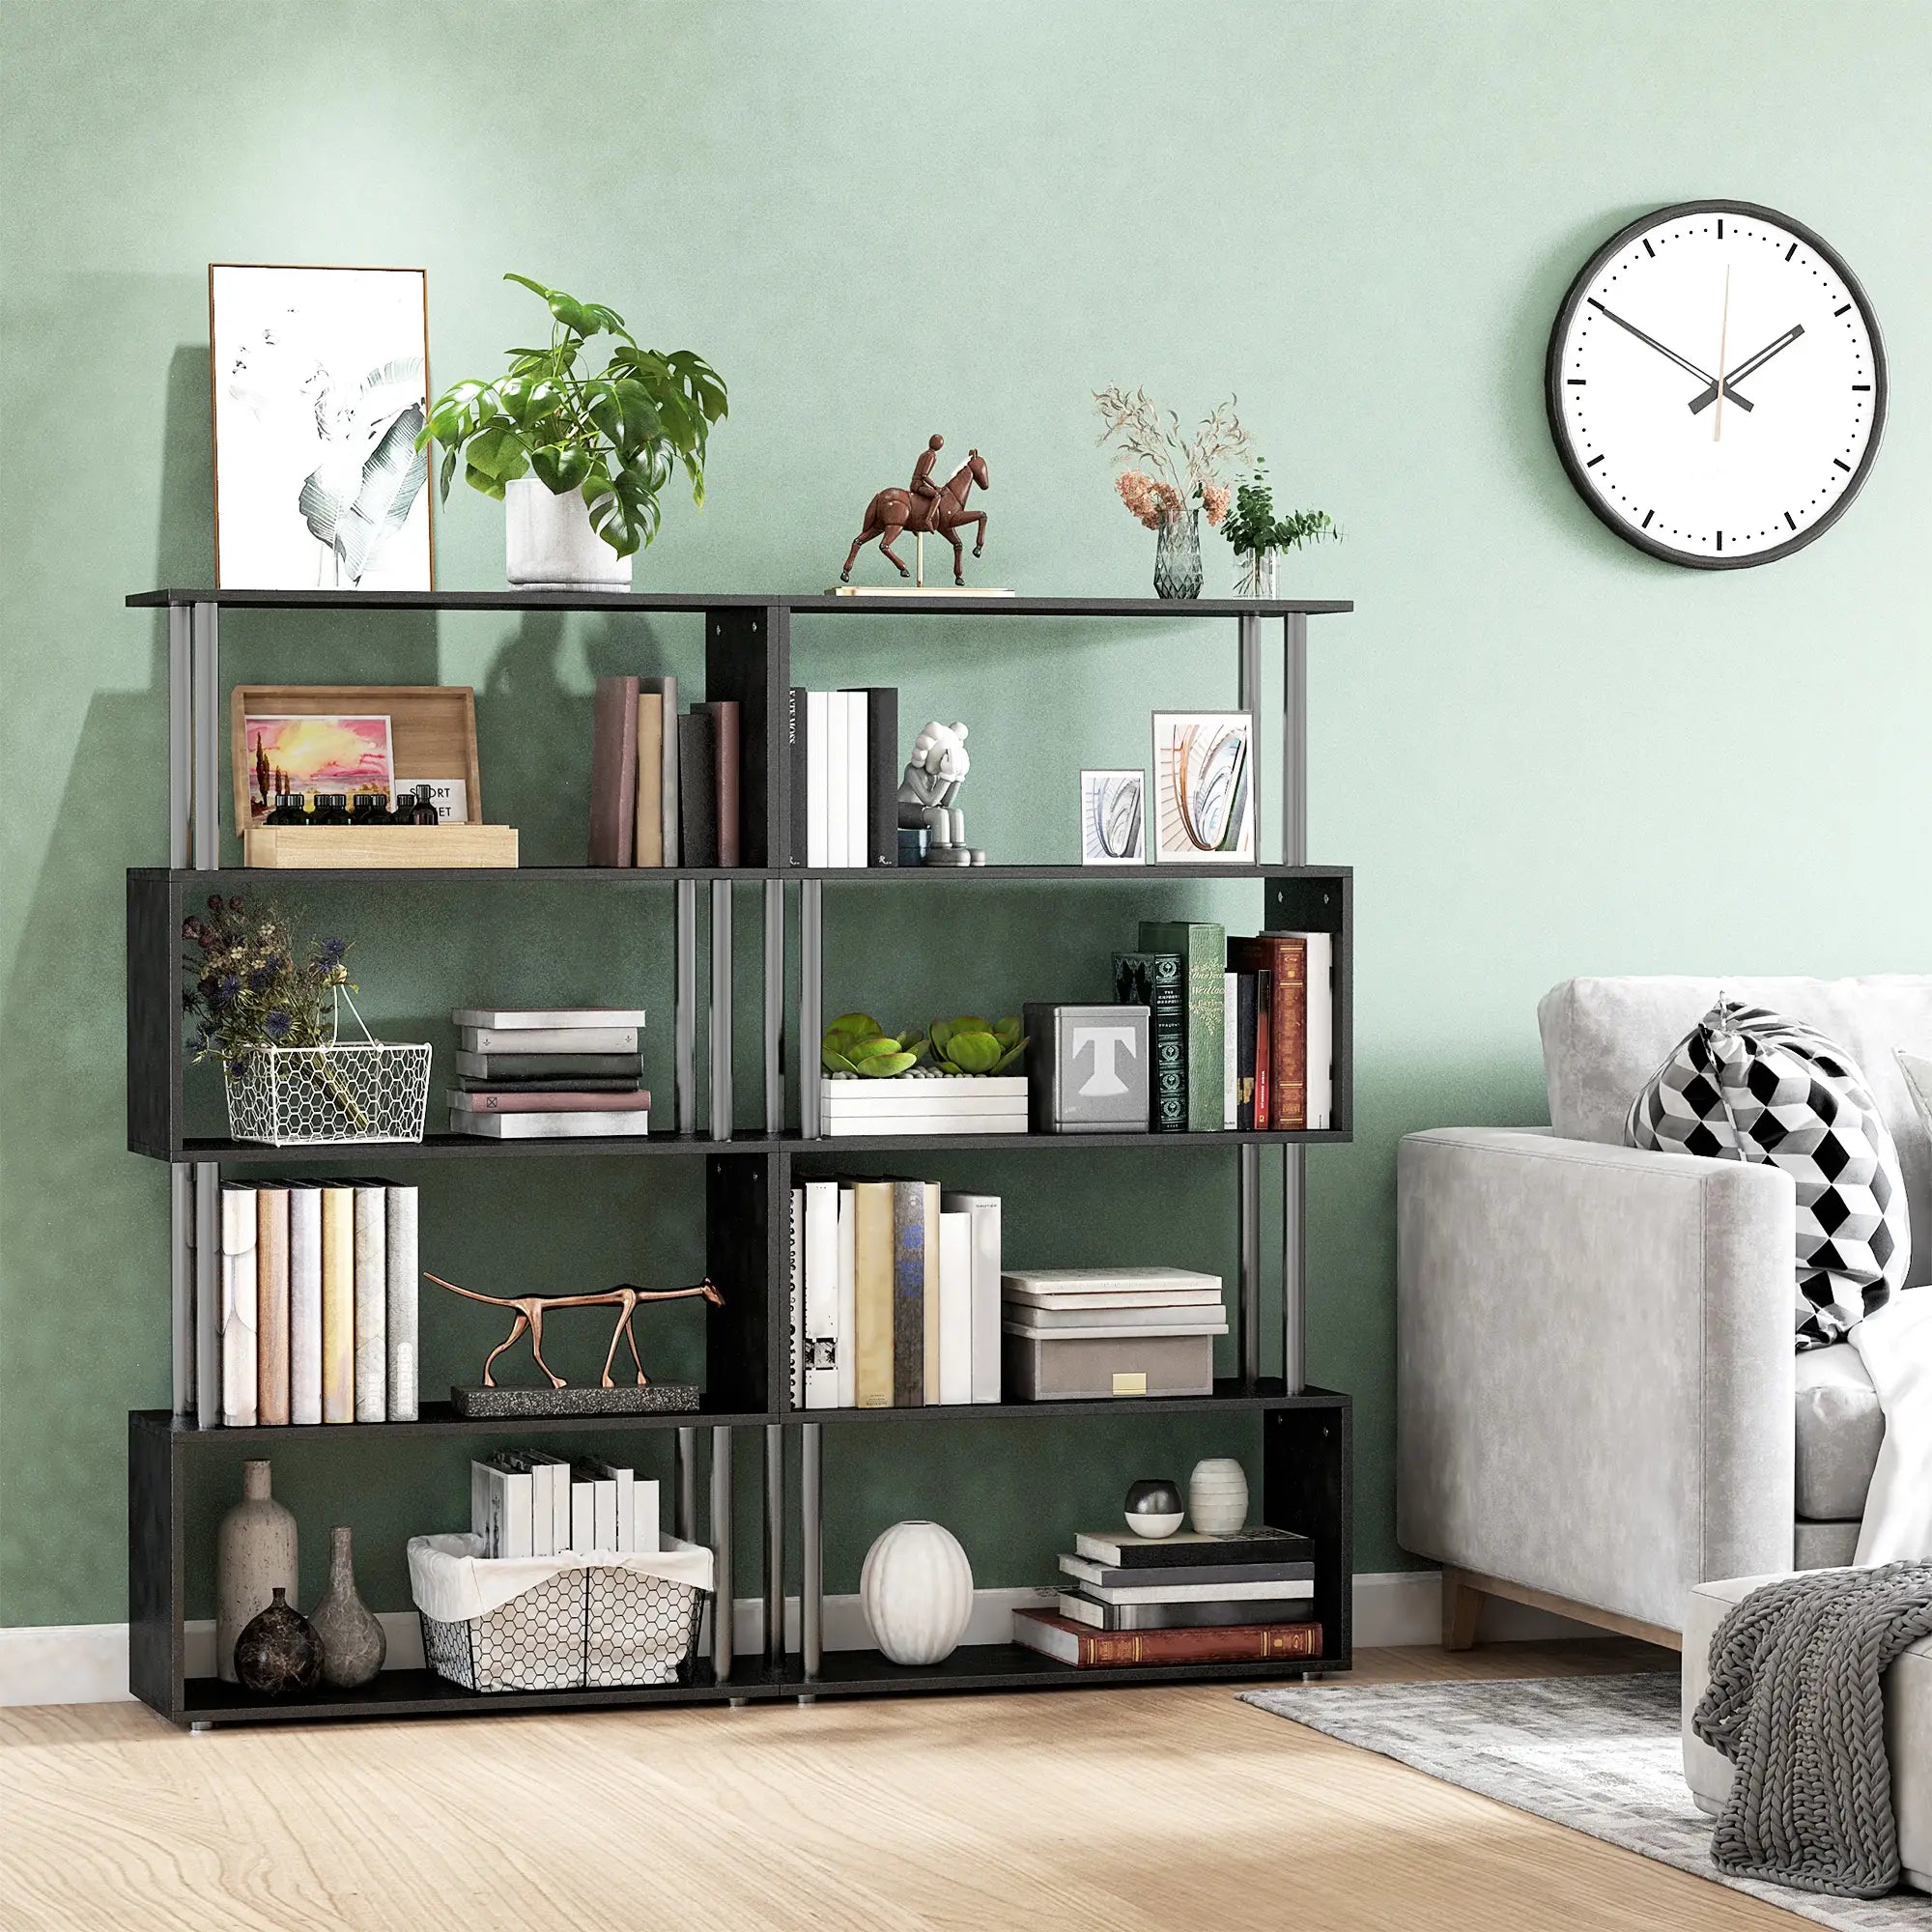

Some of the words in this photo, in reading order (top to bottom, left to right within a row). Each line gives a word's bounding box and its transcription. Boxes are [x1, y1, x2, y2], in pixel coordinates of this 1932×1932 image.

[410, 787, 451, 798] SORT
[1072, 1027, 1136, 1096] T
[399, 1344, 412, 1413] CONCRETE
